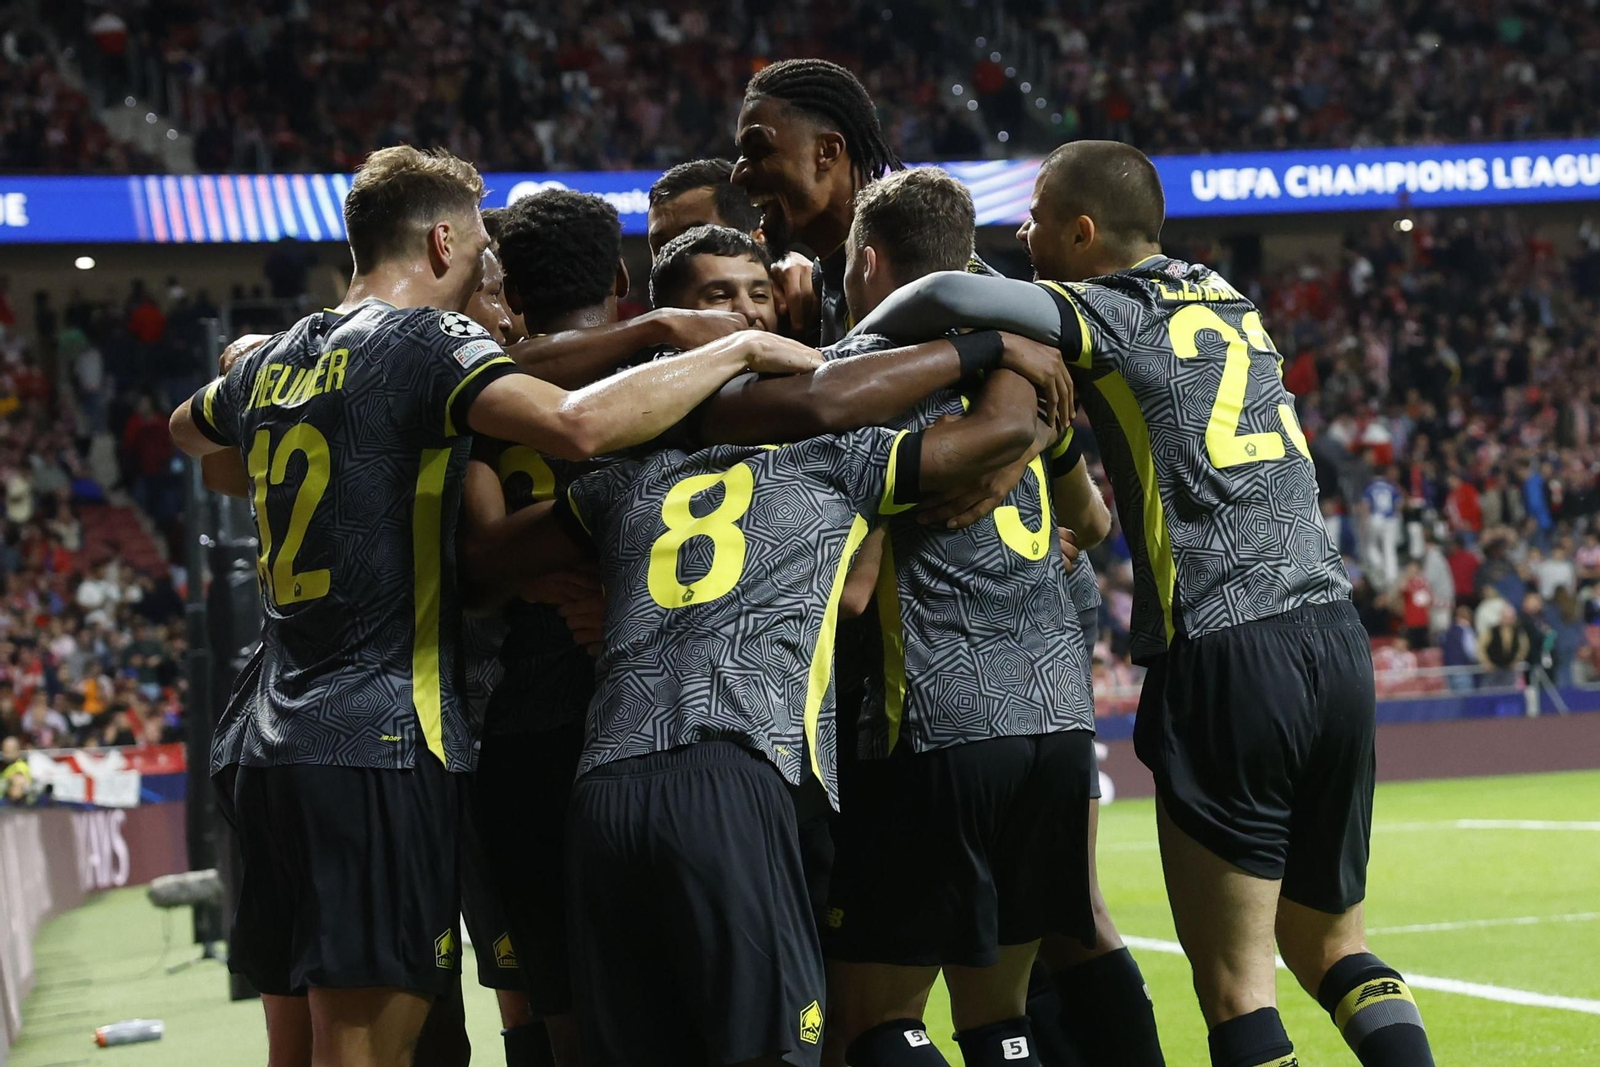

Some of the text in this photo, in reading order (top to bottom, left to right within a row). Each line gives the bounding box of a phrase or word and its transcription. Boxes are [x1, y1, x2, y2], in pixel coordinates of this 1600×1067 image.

[1190, 167, 1281, 201] UEFA
[1284, 157, 1489, 198] CHAMPIONS
[248, 422, 331, 606] 12
[647, 462, 754, 609] 8
[910, 1030, 924, 1043] 5
[1009, 1040, 1023, 1056] 5
